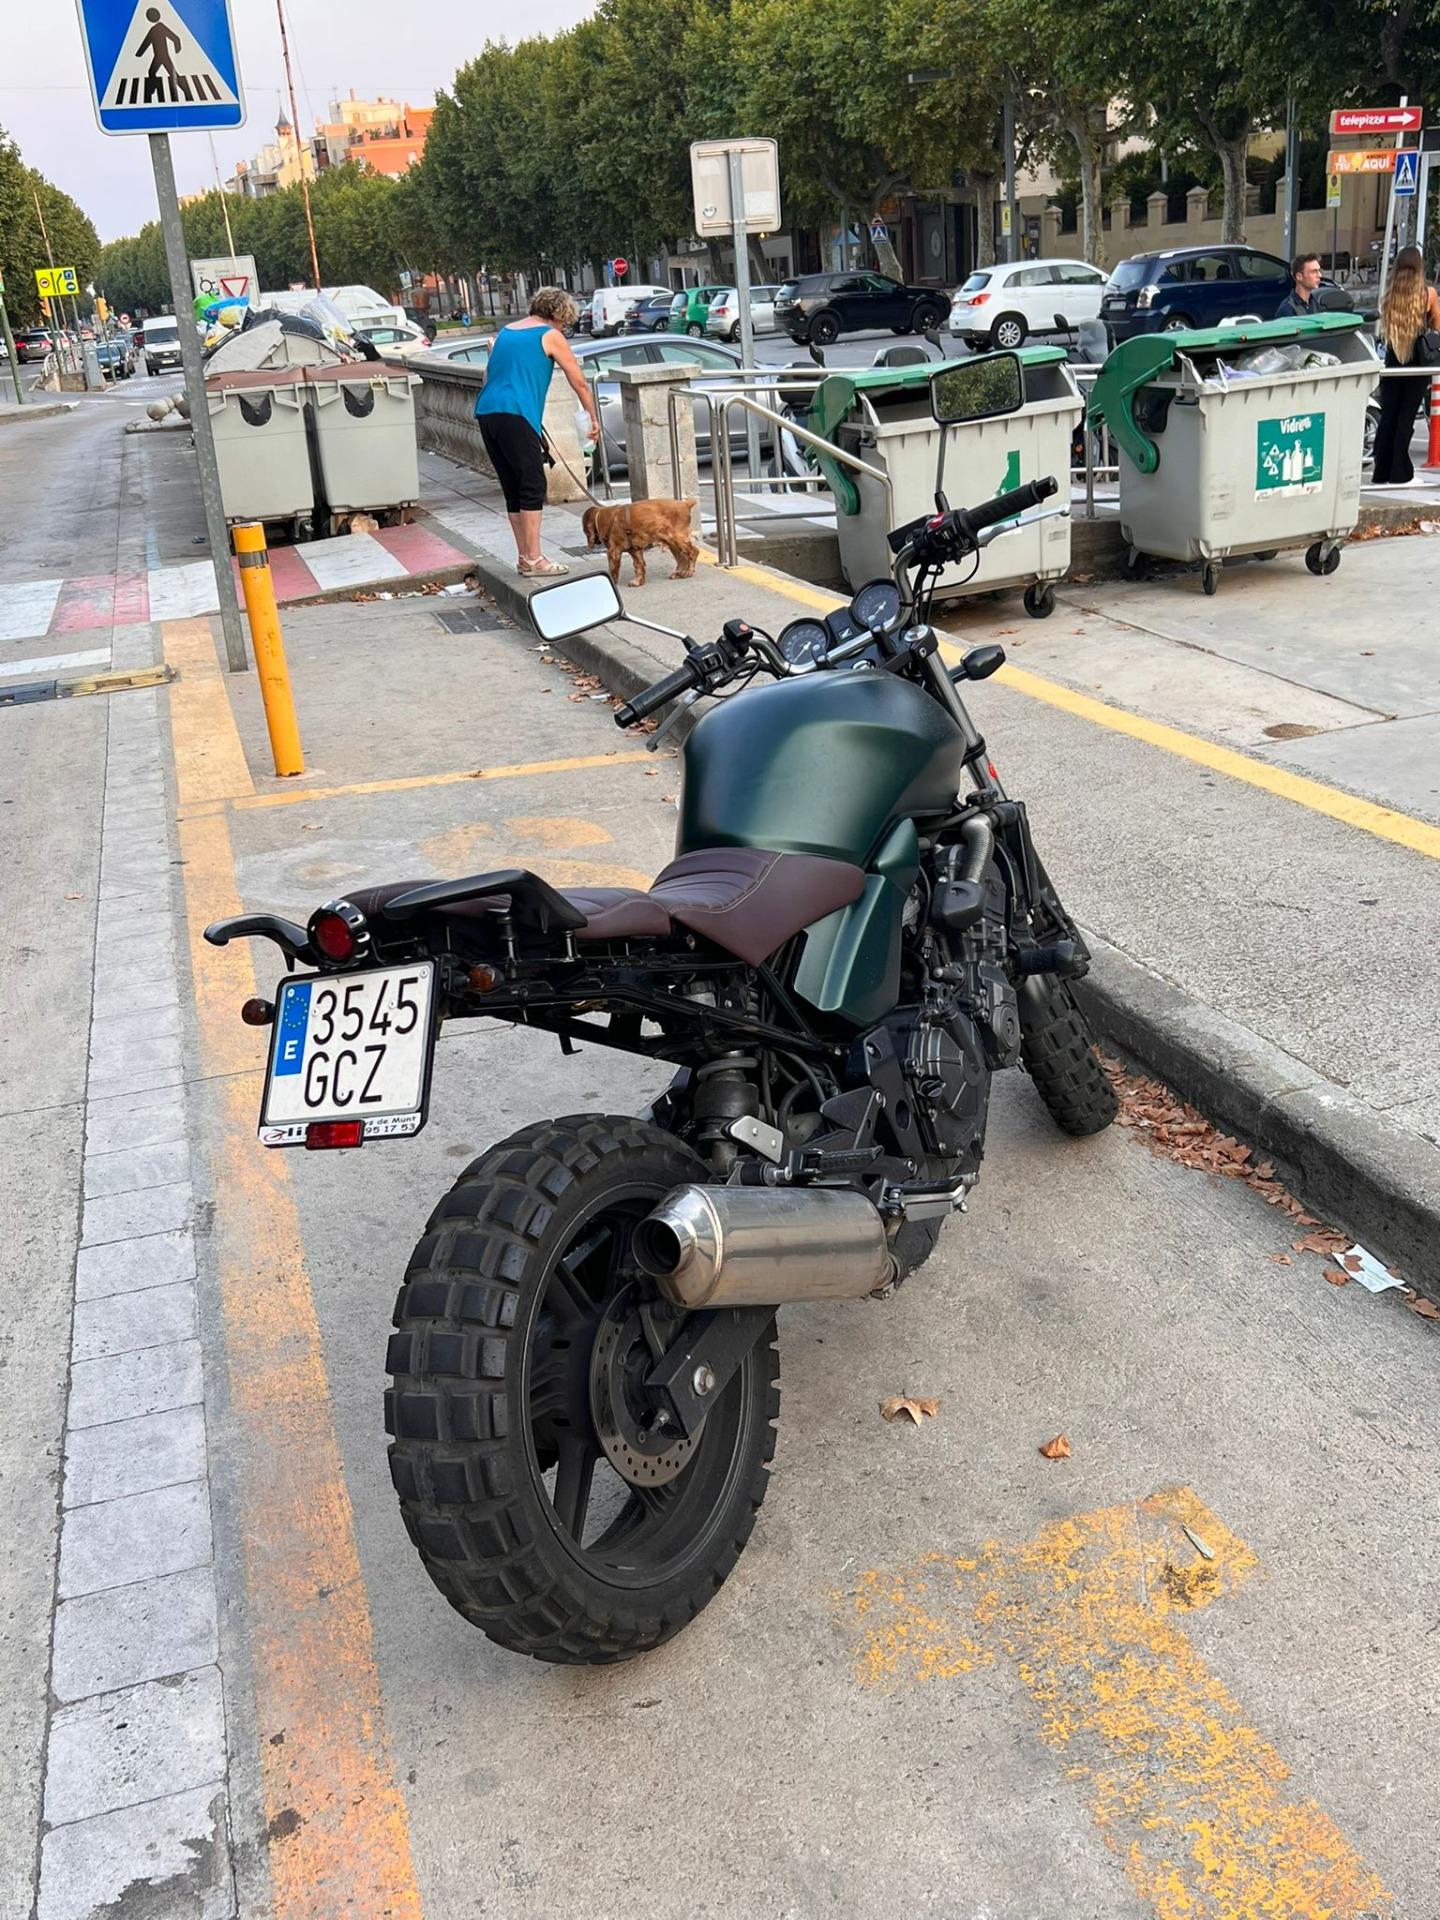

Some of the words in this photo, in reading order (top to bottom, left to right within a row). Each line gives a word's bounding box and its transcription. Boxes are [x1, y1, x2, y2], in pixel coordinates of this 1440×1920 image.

[1340, 114, 1385, 128] telepizza
[313, 977, 419, 1045] 3545
[284, 1040, 298, 1061] E
[304, 1044, 387, 1108] GCZ
[384, 1125, 397, 1133] 17
[401, 1123, 416, 1131] 53
[392, 1116, 416, 1124] Munt
